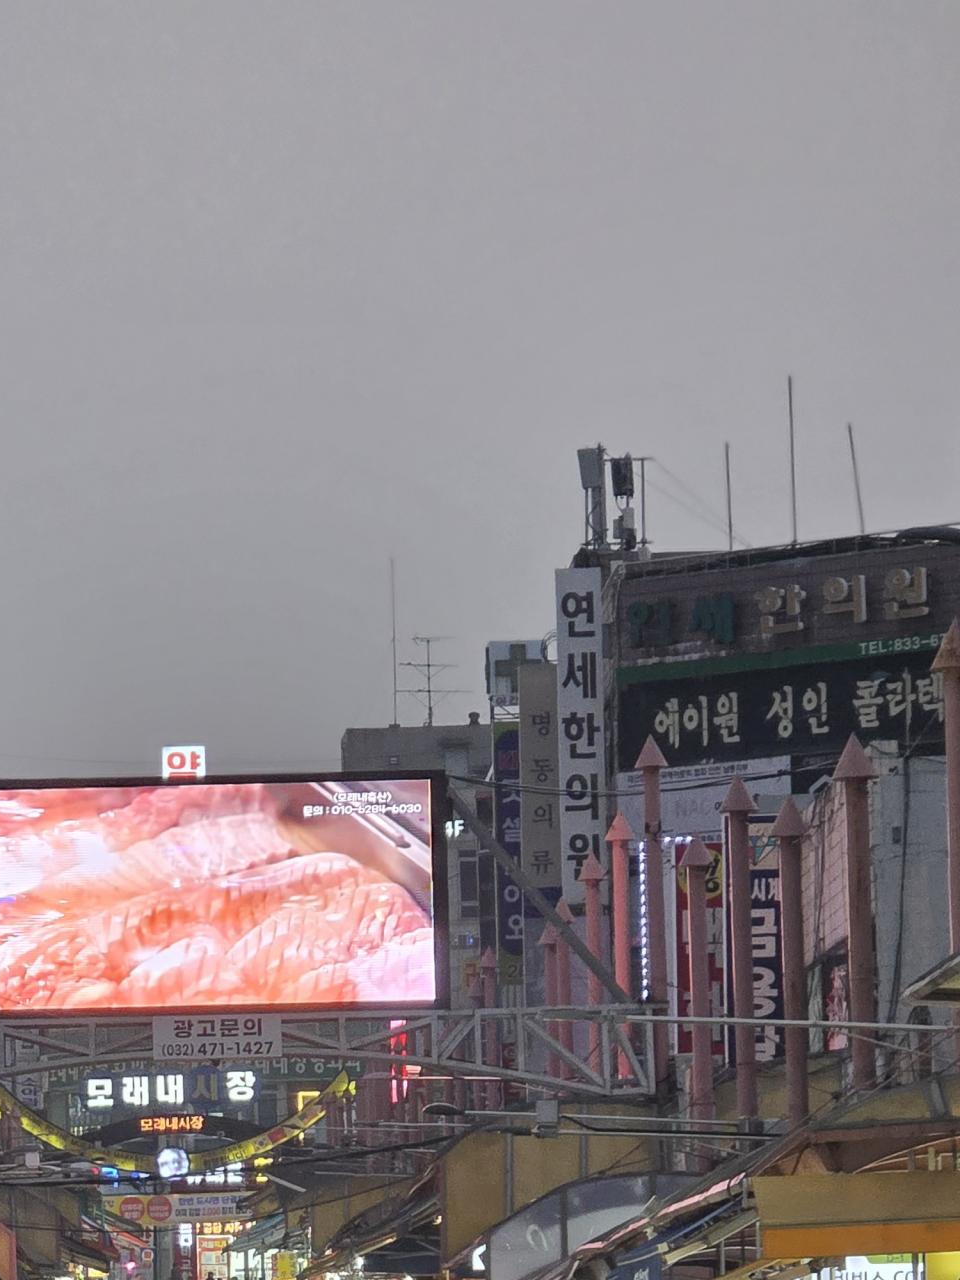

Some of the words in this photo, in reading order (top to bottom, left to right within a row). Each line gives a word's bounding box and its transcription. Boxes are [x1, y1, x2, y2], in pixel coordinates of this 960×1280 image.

[654, 691, 740, 749] 에이원
[766, 682, 830, 739] 성인
[561, 591, 601, 880] 연세한의원
[303, 804, 323, 818] 문의
[173, 1018, 262, 1038] 광고문의
[87, 1071, 256, 1107] 모래내시장
[140, 1115, 204, 1131] 모래내시장
